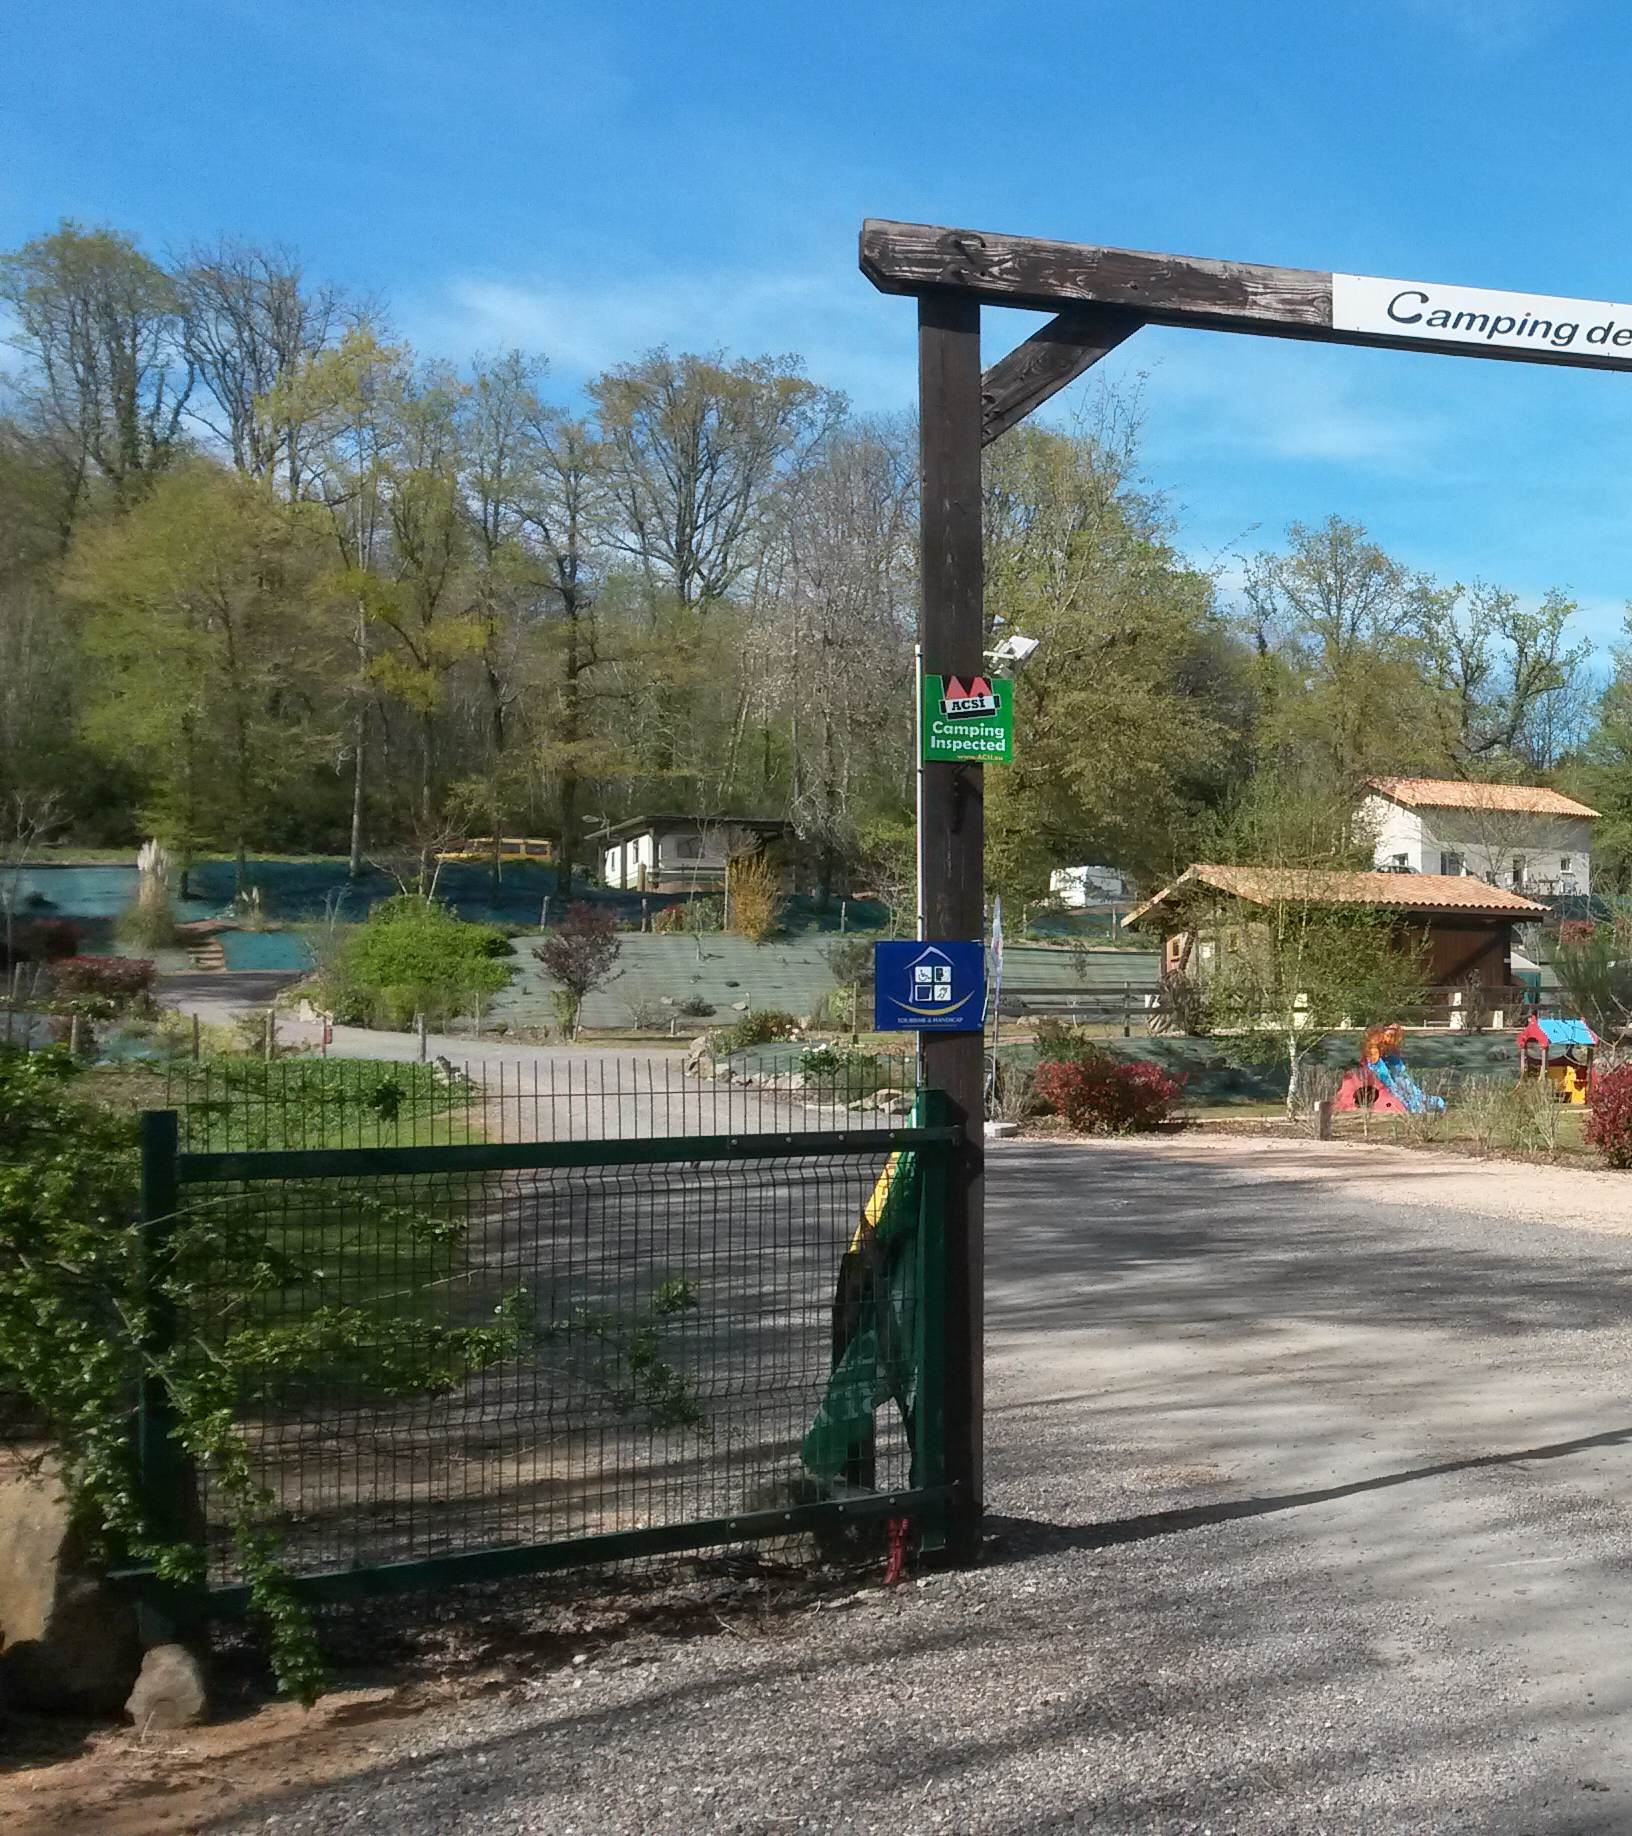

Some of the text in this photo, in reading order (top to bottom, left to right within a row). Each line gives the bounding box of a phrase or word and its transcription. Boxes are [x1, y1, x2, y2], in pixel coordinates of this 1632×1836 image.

[1387, 291, 1580, 347] Camping
[951, 692, 986, 711] ACSI
[932, 721, 1004, 739] Camping
[930, 736, 1006, 752] Inspected
